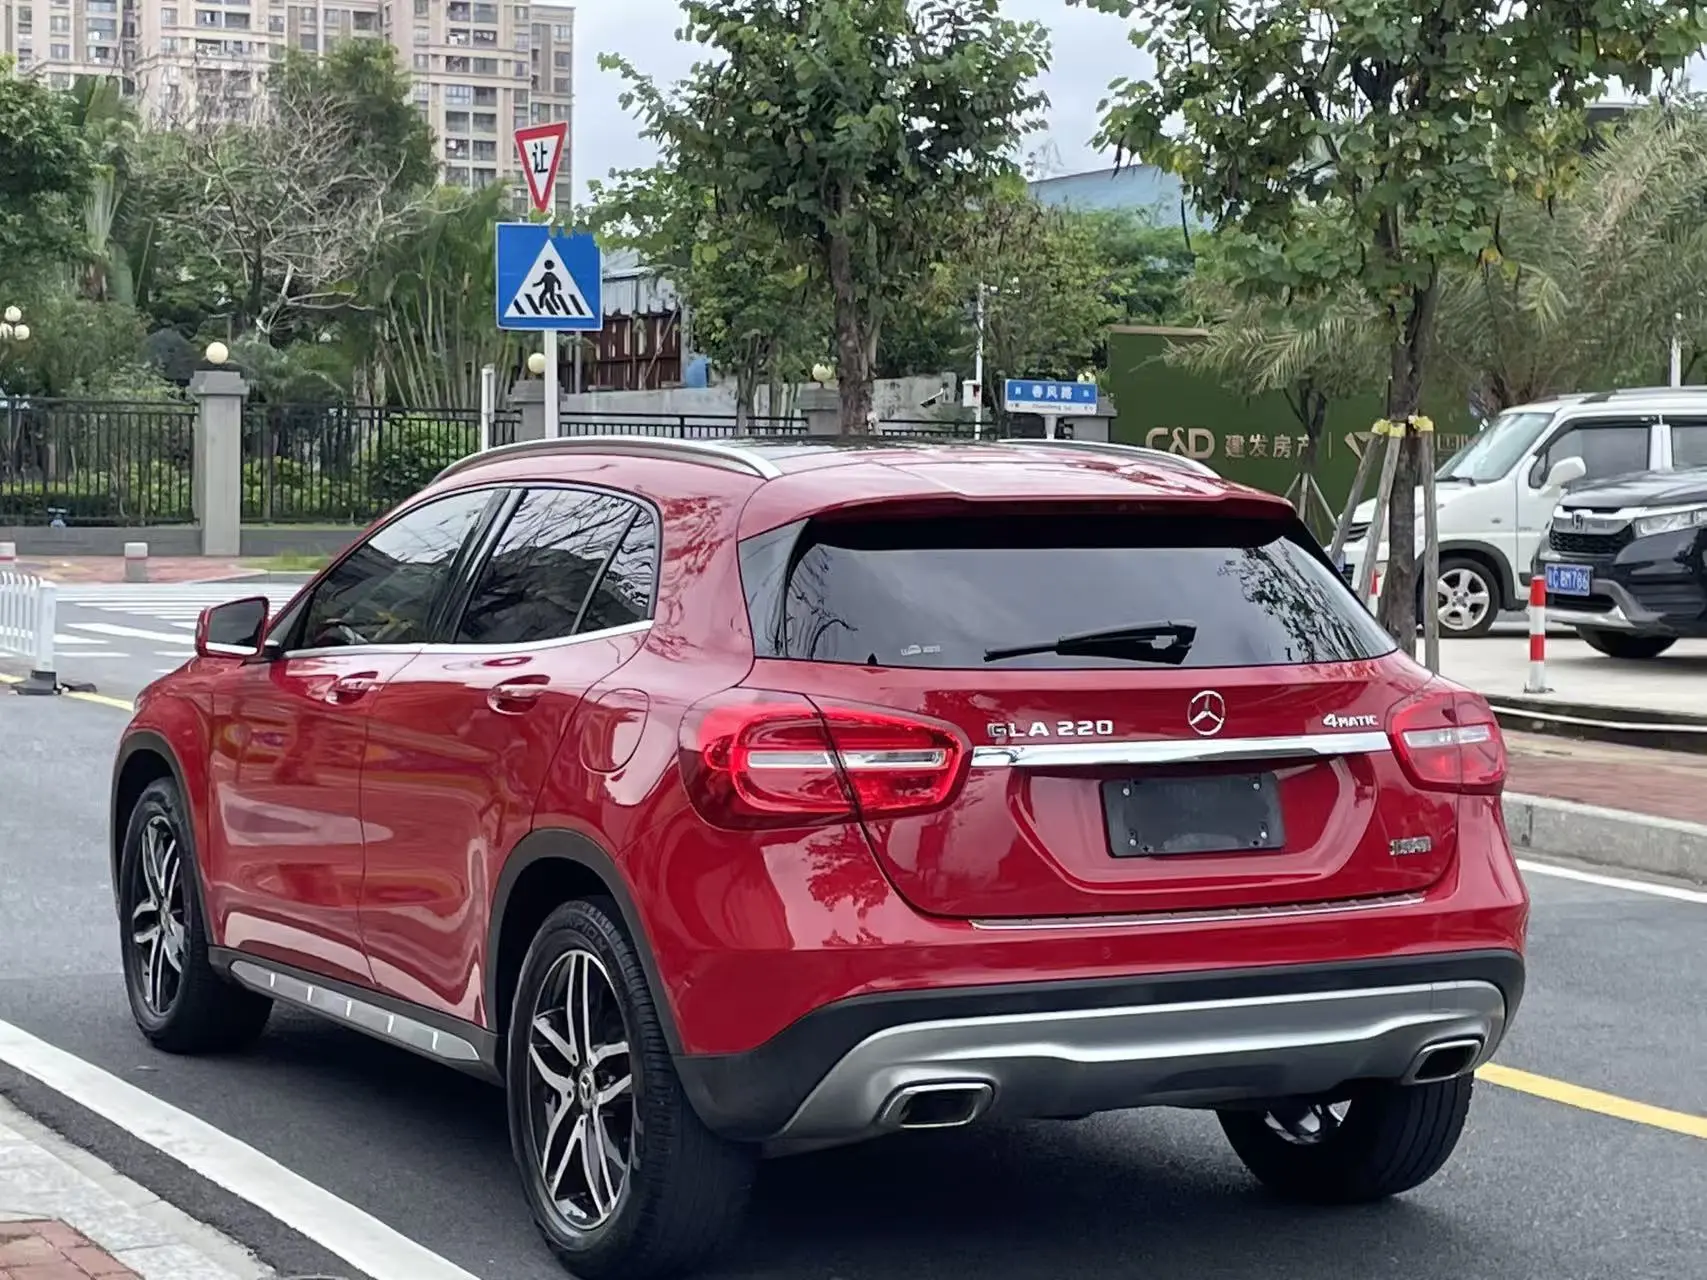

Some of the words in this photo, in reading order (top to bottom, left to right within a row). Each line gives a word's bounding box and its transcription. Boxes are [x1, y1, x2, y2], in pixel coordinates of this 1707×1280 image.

[532, 141, 549, 173] 让
[1145, 426, 1216, 459] C&D
[1224, 433, 1310, 459] 建发房产
[987, 720, 1050, 737] GLA
[1056, 719, 1114, 736] 220
[1322, 713, 1379, 728] 4MATIC
